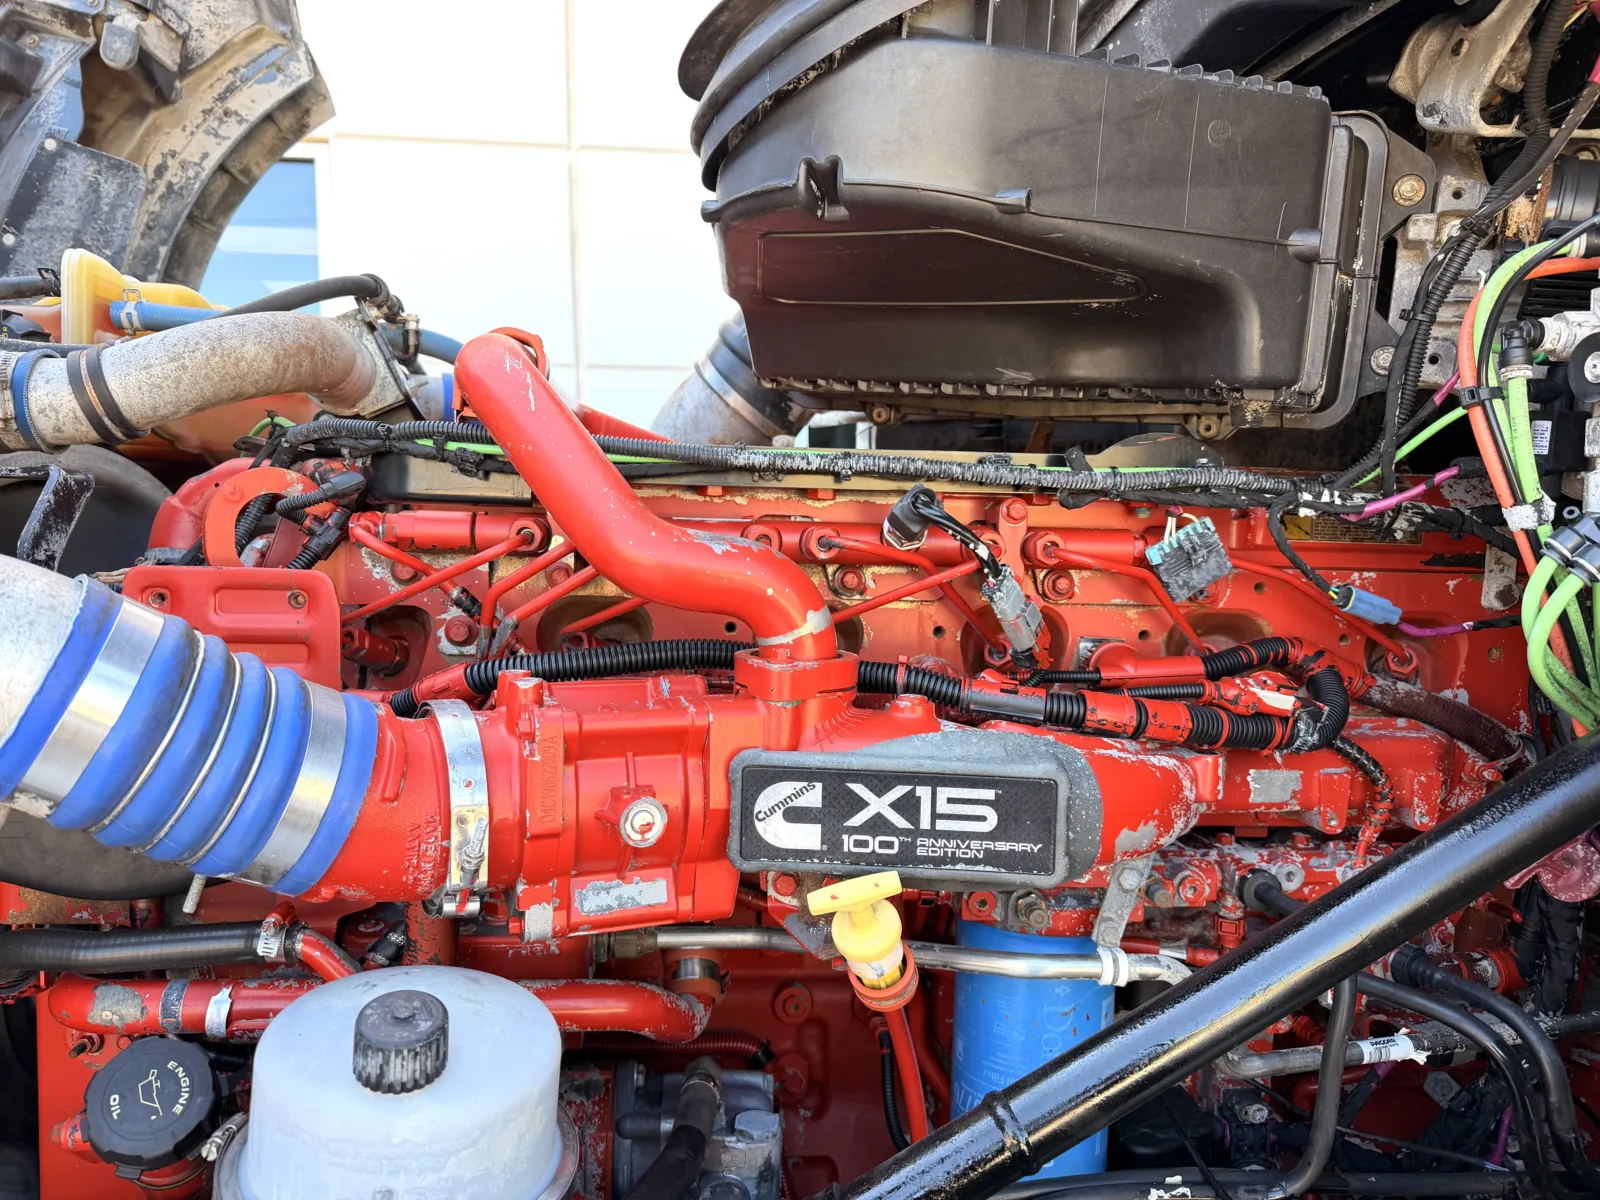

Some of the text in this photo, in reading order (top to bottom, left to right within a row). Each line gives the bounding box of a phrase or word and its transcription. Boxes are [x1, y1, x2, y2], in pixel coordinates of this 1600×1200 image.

[755, 782, 816, 822] Cummins
[917, 838, 1042, 853] ANNIVERSARY
[917, 847, 984, 859] EDITION
[1369, 1038, 1397, 1047] PACCAR
[167, 1061, 190, 1115] ENGINE
[109, 1094, 121, 1119] OIL
